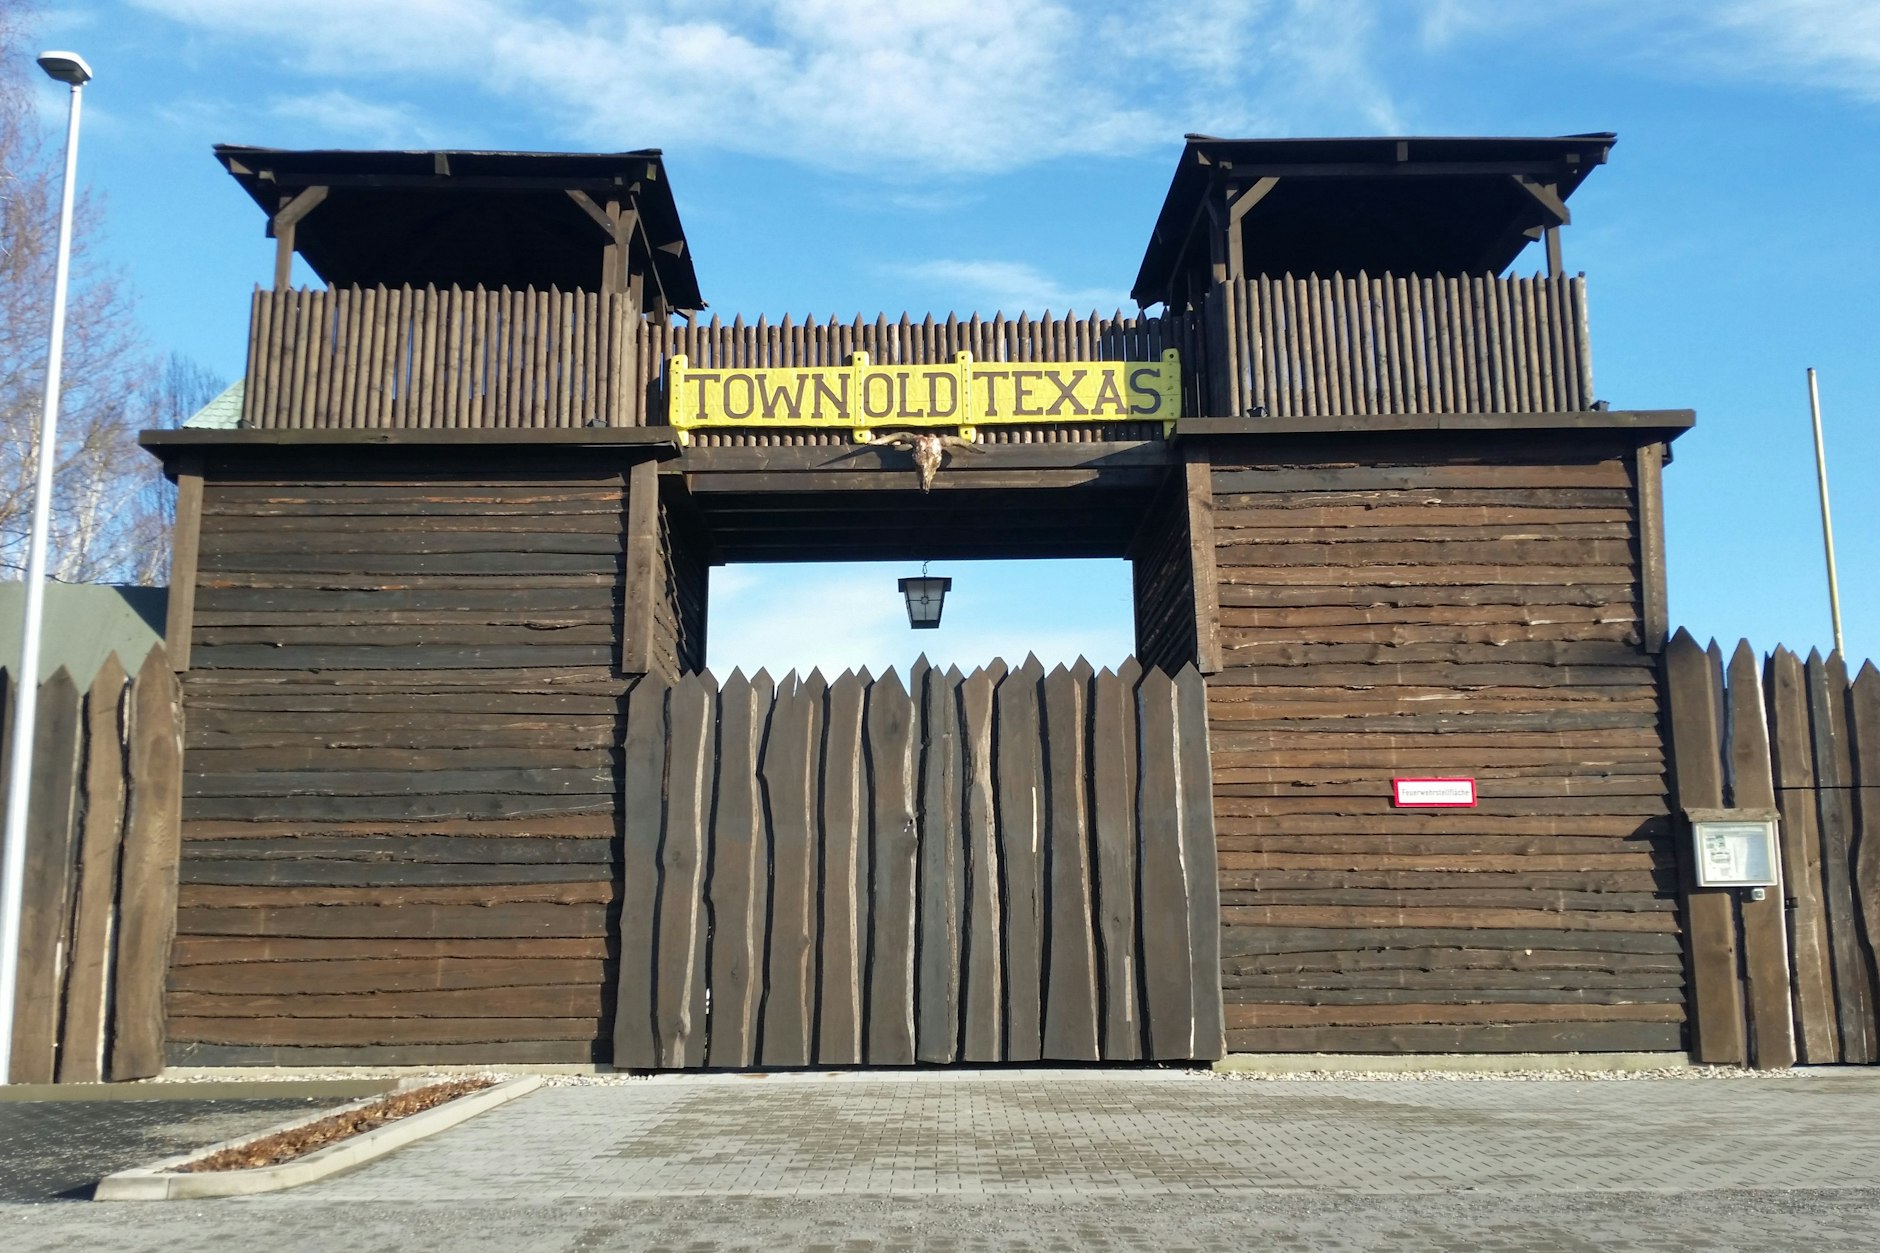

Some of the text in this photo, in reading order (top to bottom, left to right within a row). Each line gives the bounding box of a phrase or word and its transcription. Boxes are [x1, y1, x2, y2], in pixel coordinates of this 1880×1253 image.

[684, 368, 1162, 420] TOWN OLD TEXAS
